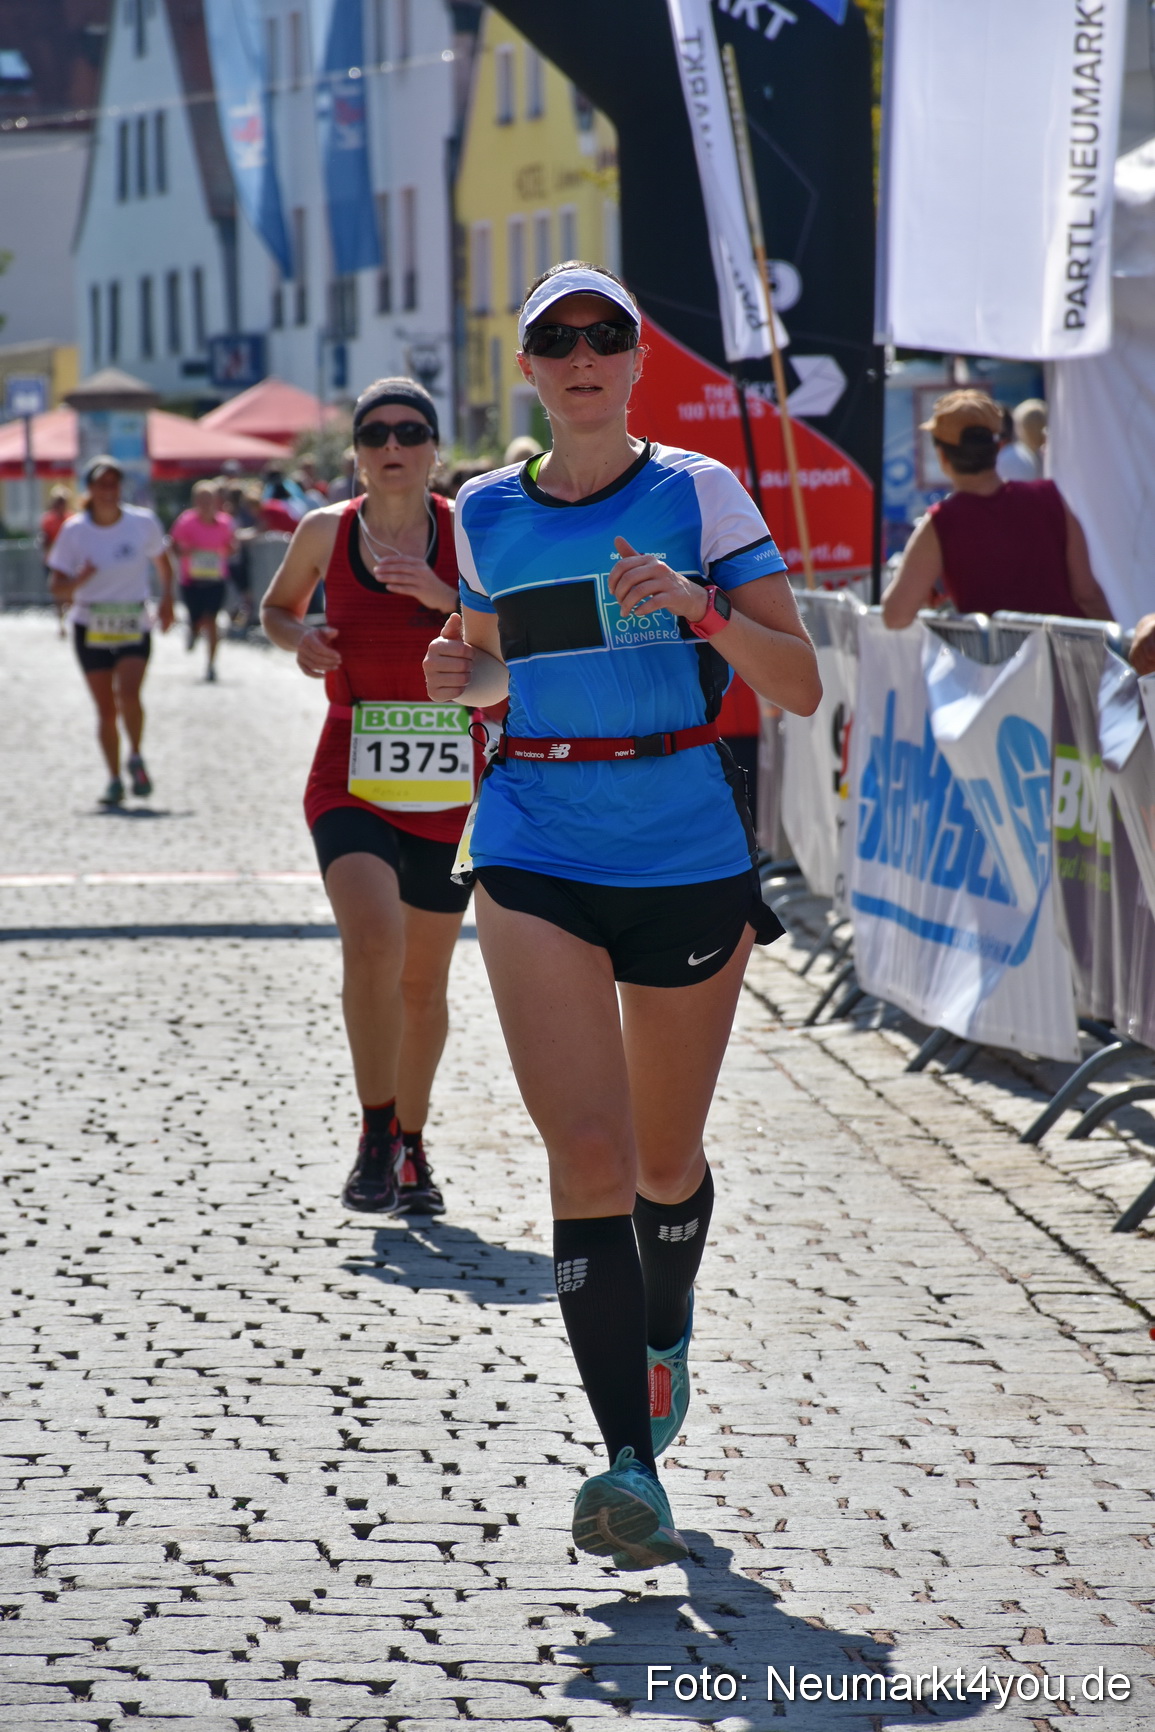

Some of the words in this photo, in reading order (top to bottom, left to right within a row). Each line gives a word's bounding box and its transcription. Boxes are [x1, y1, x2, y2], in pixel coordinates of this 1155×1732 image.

[1065, 209, 1096, 330] PARTL
[709, 402, 764, 420] YEAS
[745, 467, 851, 492] Lausport
[615, 630, 680, 645] NÜRNBERG
[361, 706, 465, 732] BOCK
[366, 741, 460, 774] 1375
[614, 750, 630, 758] new
[557, 1279, 586, 1294] cep
